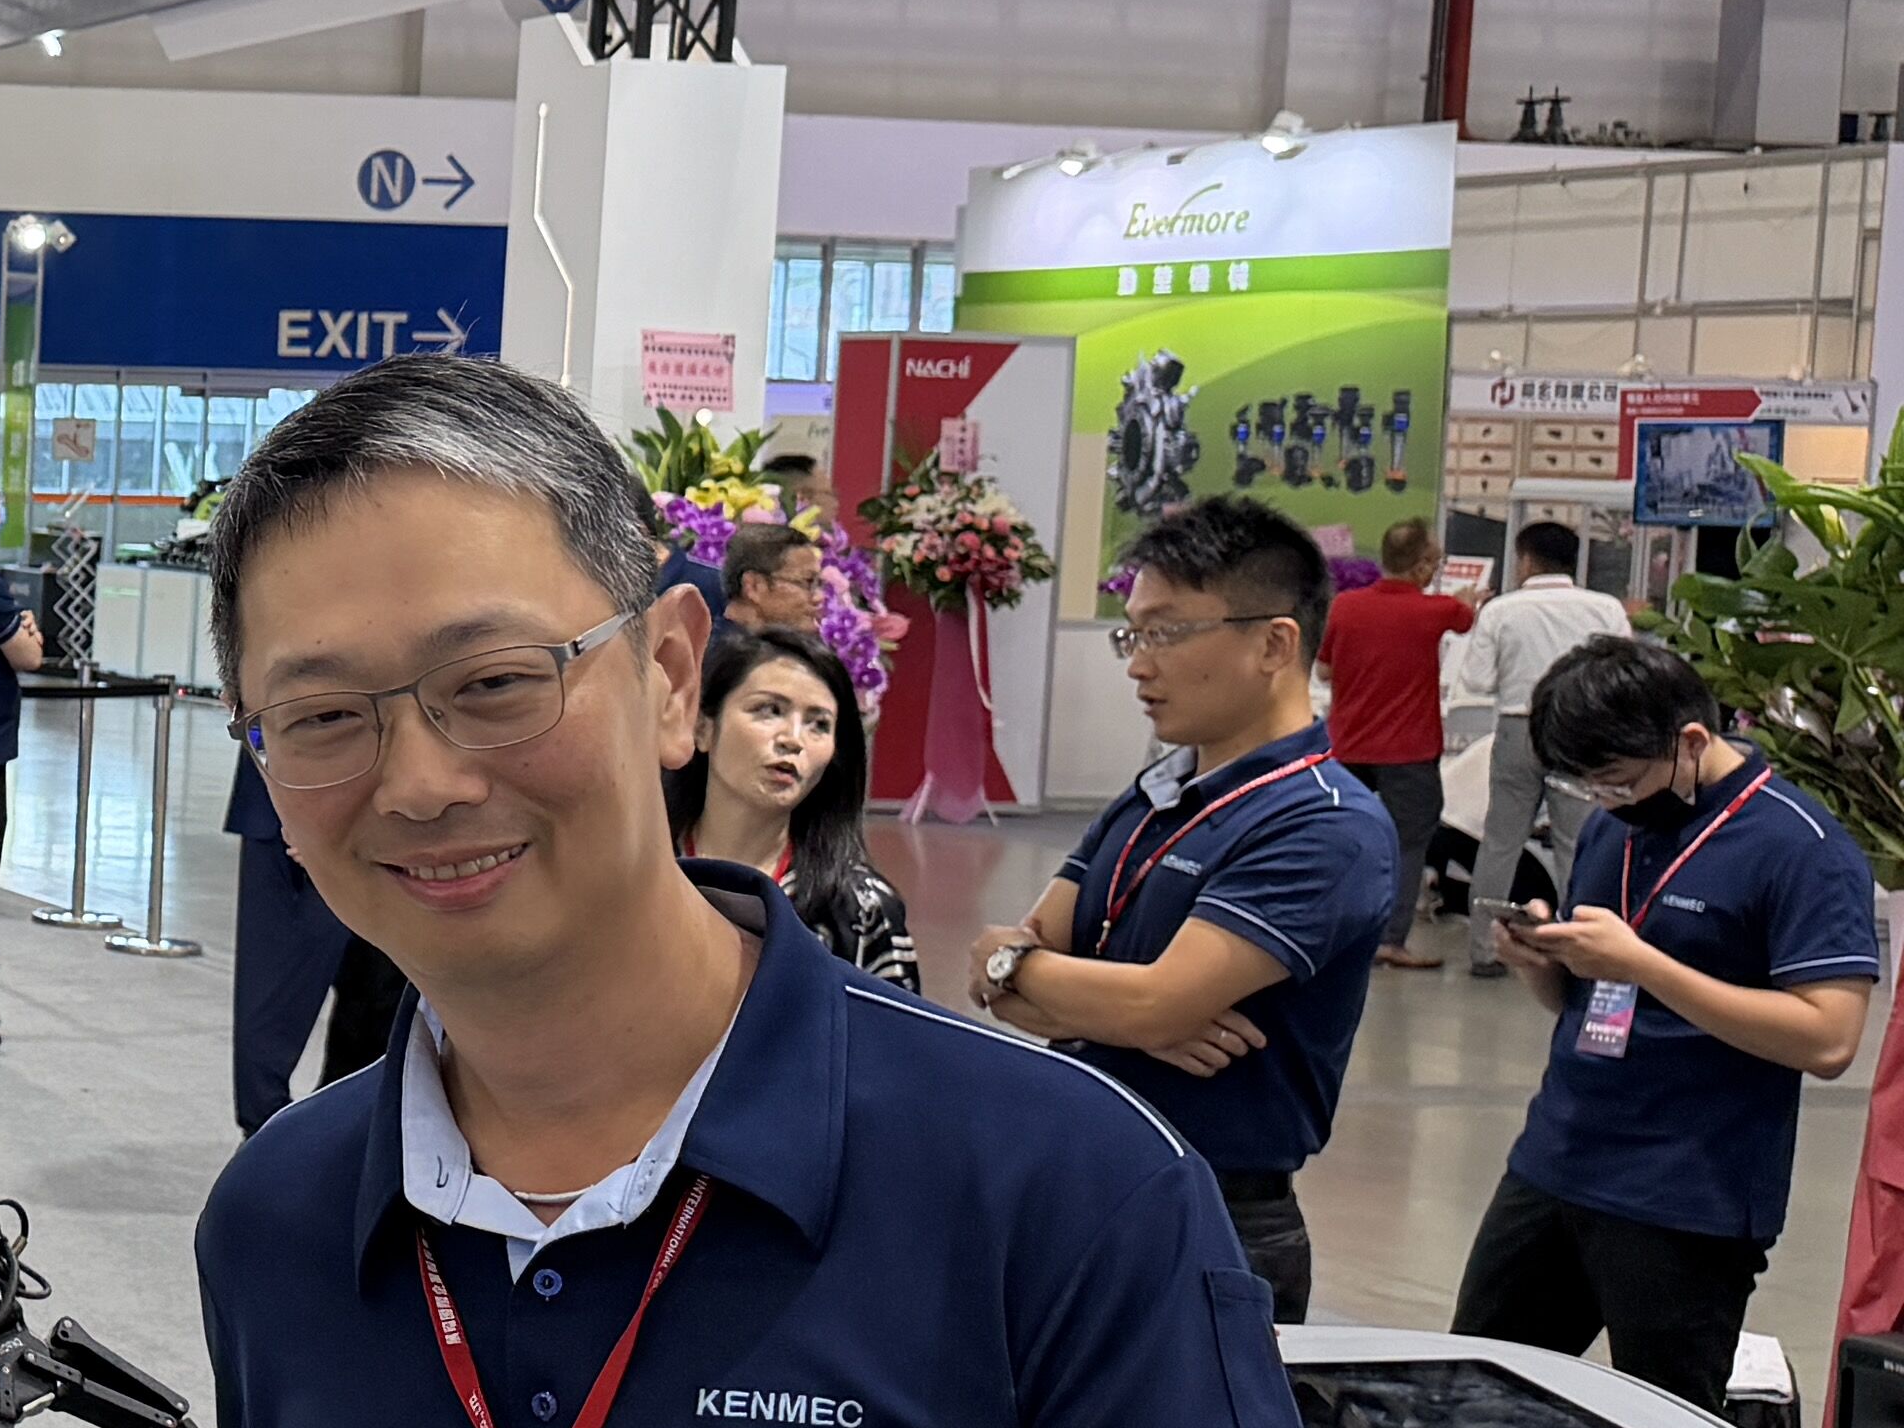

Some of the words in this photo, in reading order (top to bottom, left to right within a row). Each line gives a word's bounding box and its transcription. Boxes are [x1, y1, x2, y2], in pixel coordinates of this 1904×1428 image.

[1123, 183, 1250, 240] Evermore
[277, 308, 409, 359] EXIT
[696, 1388, 863, 1428] KENMEC
